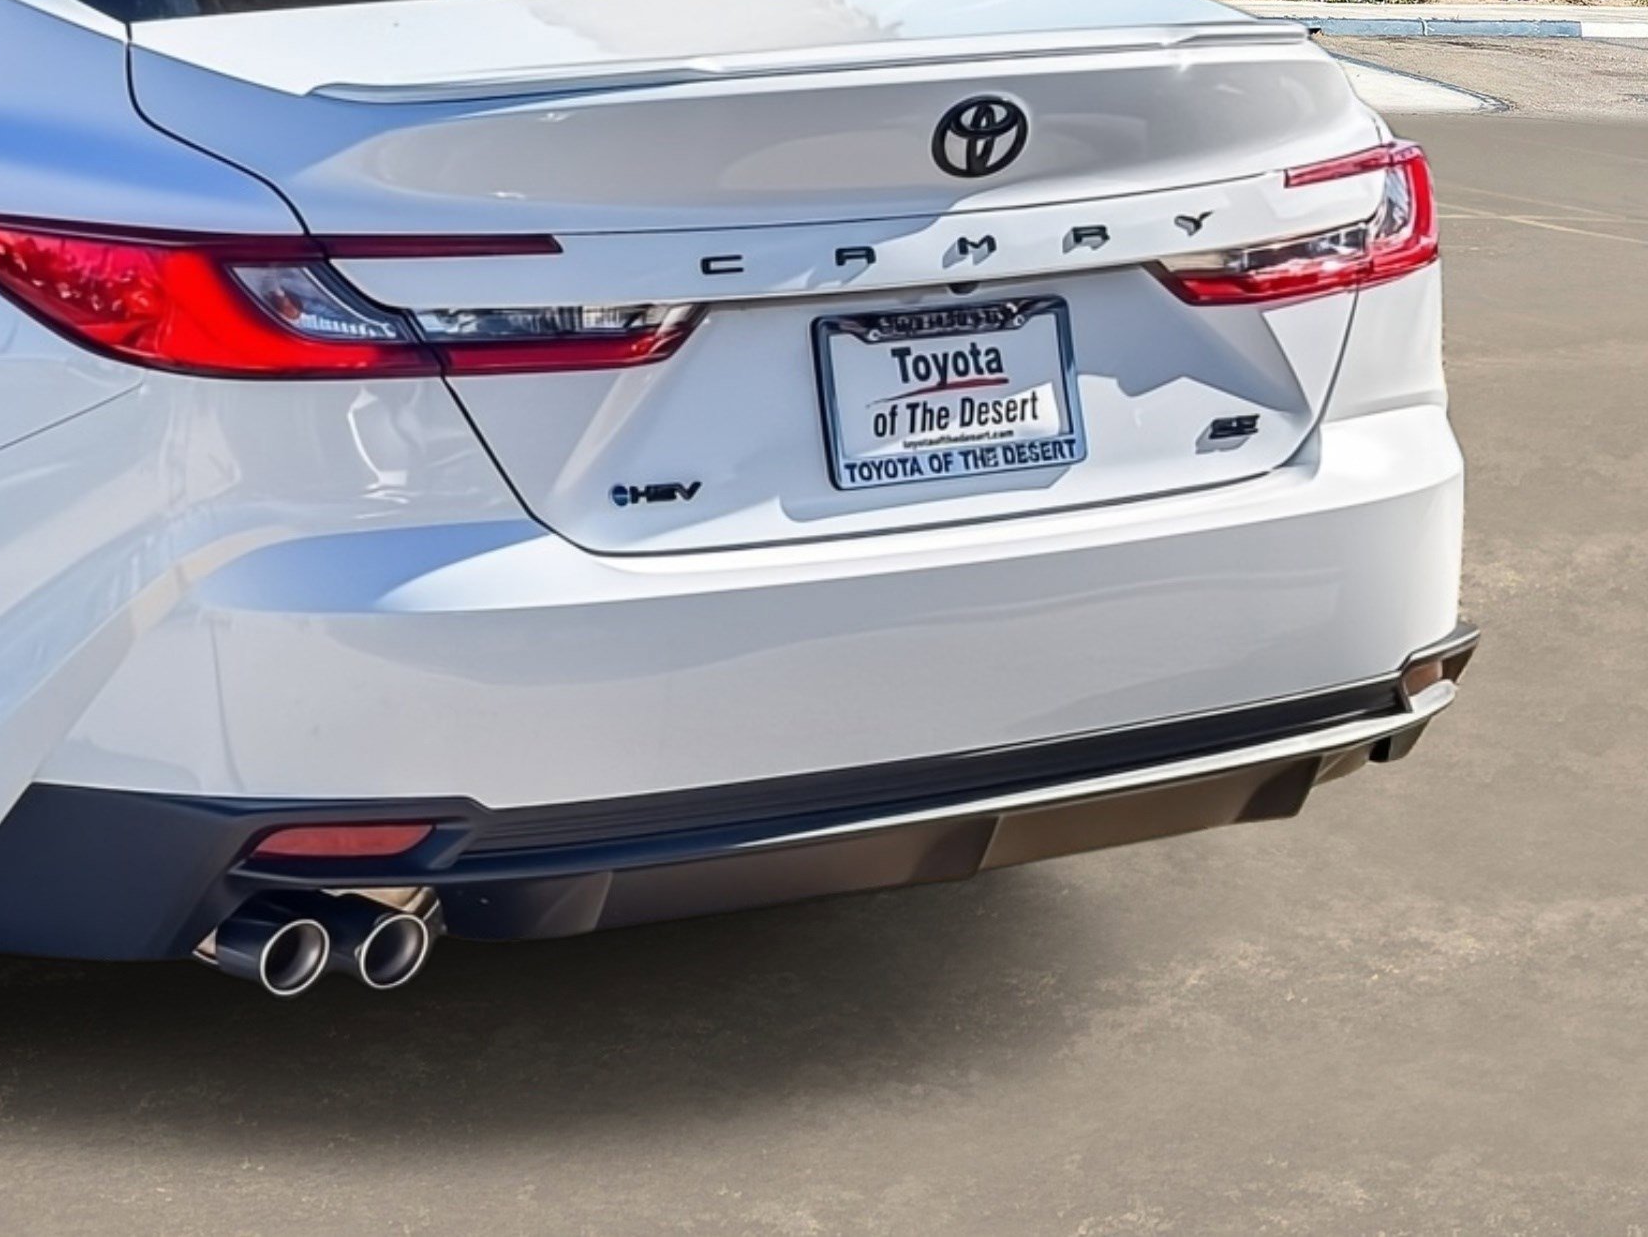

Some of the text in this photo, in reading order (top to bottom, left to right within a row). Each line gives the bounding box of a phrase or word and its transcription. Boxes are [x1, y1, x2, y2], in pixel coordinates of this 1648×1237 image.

[700, 210, 1214, 275] CAMRY
[890, 341, 1004, 388] Toyota
[873, 391, 1039, 438] of The Desert
[844, 439, 1077, 483] TOYOTA OF THE DESERT
